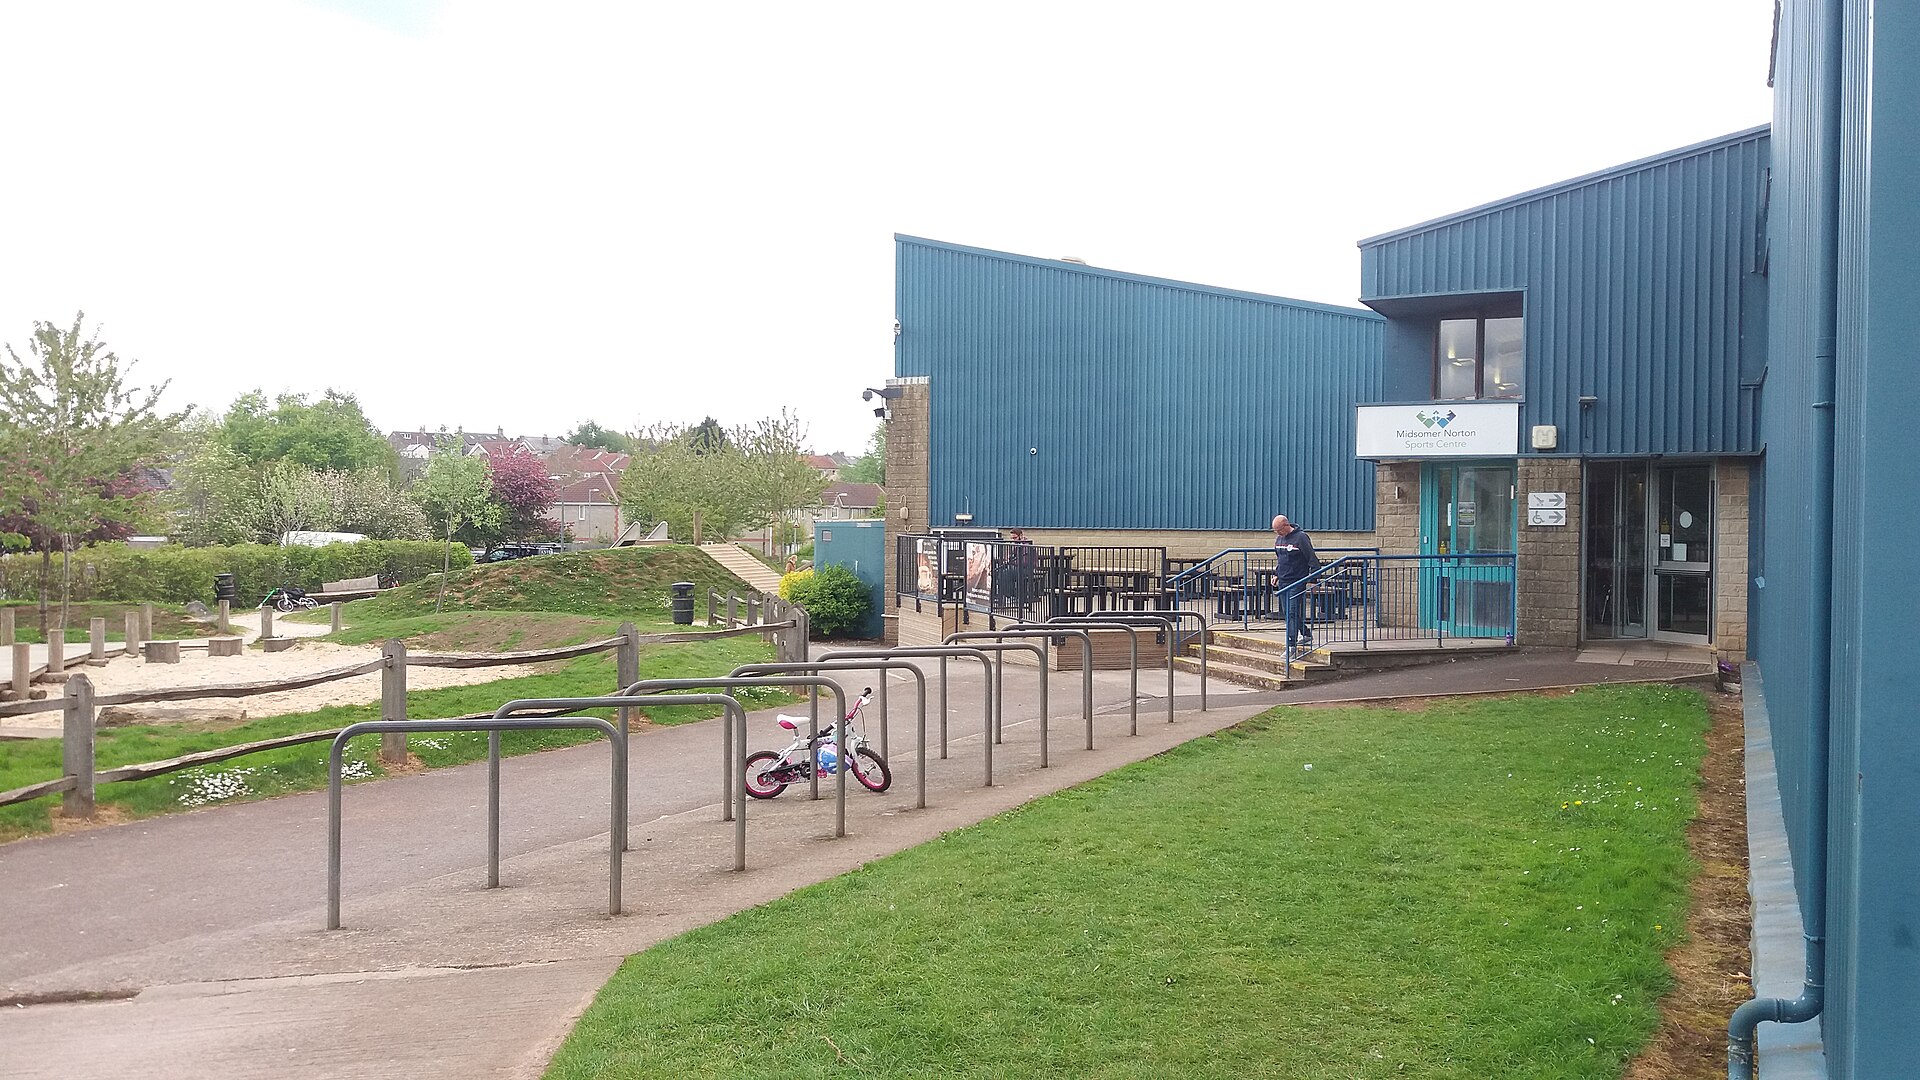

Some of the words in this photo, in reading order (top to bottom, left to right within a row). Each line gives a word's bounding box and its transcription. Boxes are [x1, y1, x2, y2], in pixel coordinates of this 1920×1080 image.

[1396, 430, 1440, 438] Midsomer
[1405, 440, 1434, 450] Sports
[1436, 440, 1466, 448] Centre
